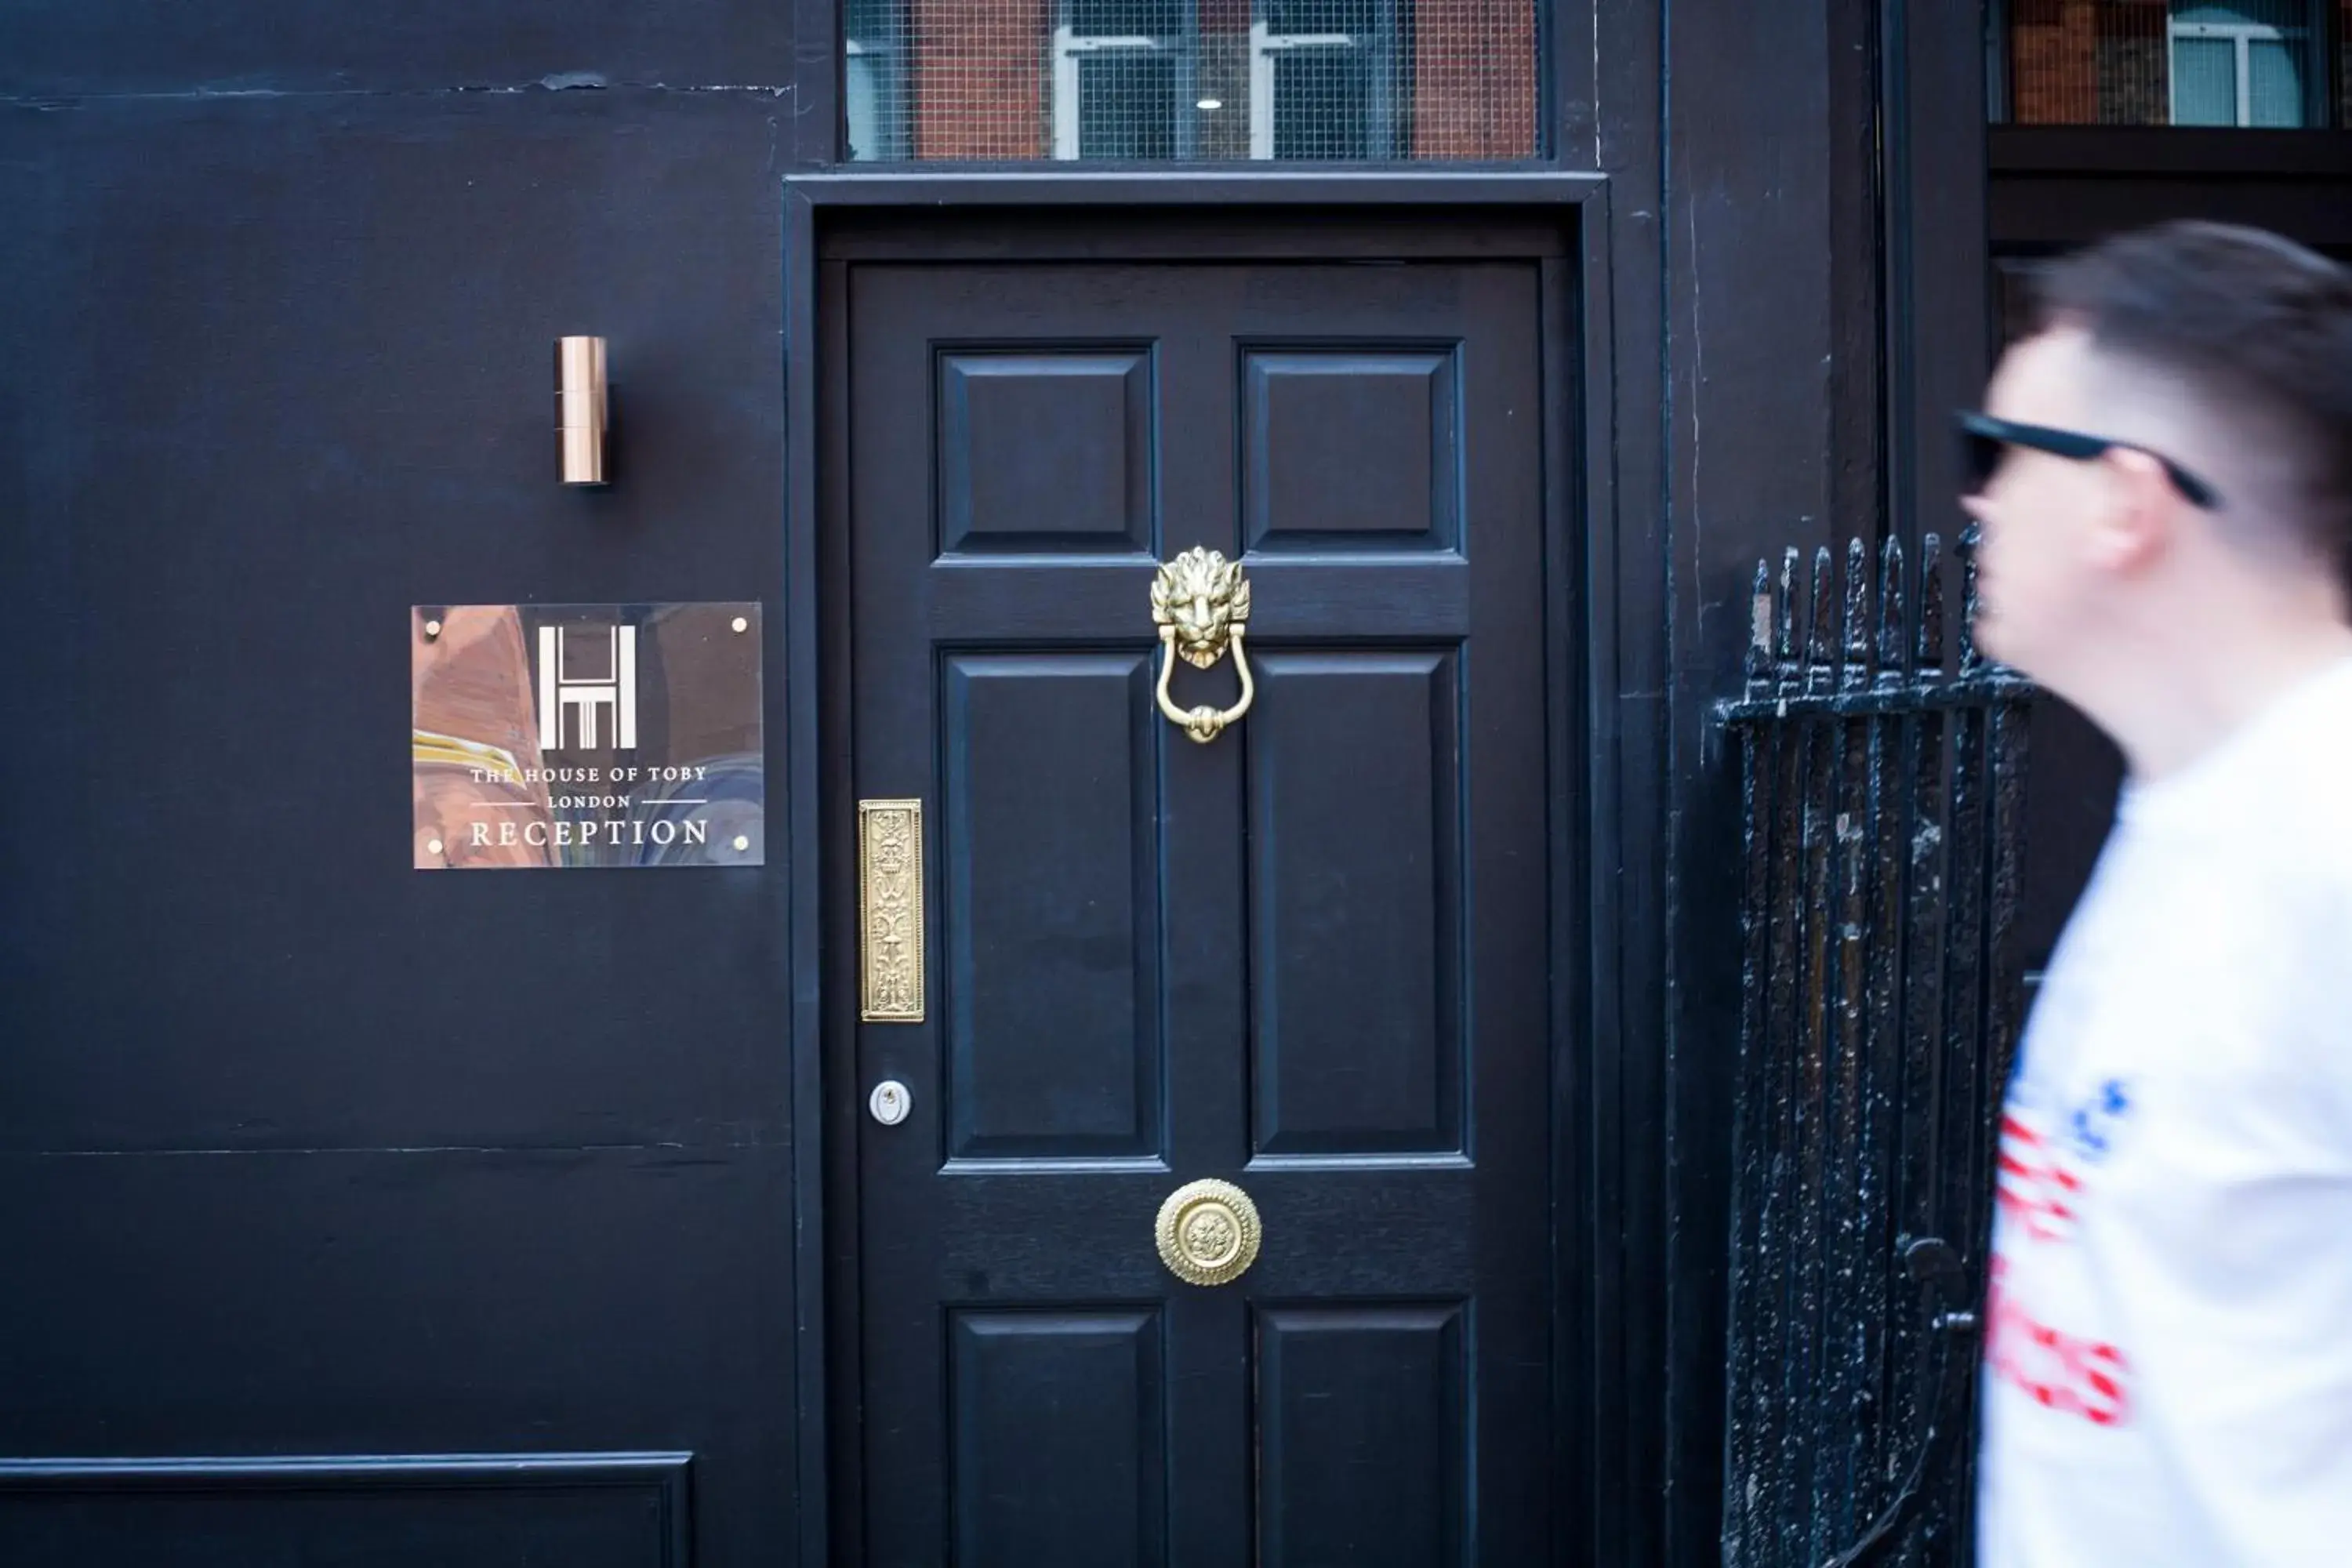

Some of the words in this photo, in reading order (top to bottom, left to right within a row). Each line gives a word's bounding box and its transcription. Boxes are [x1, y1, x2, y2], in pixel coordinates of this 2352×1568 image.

[471, 768, 515, 782] THE
[526, 768, 600, 782] HOUSE
[609, 768, 639, 782] OF
[648, 766, 706, 782] TOBY
[548, 795, 630, 808] LONDON
[470, 819, 707, 846] RECEPTION
